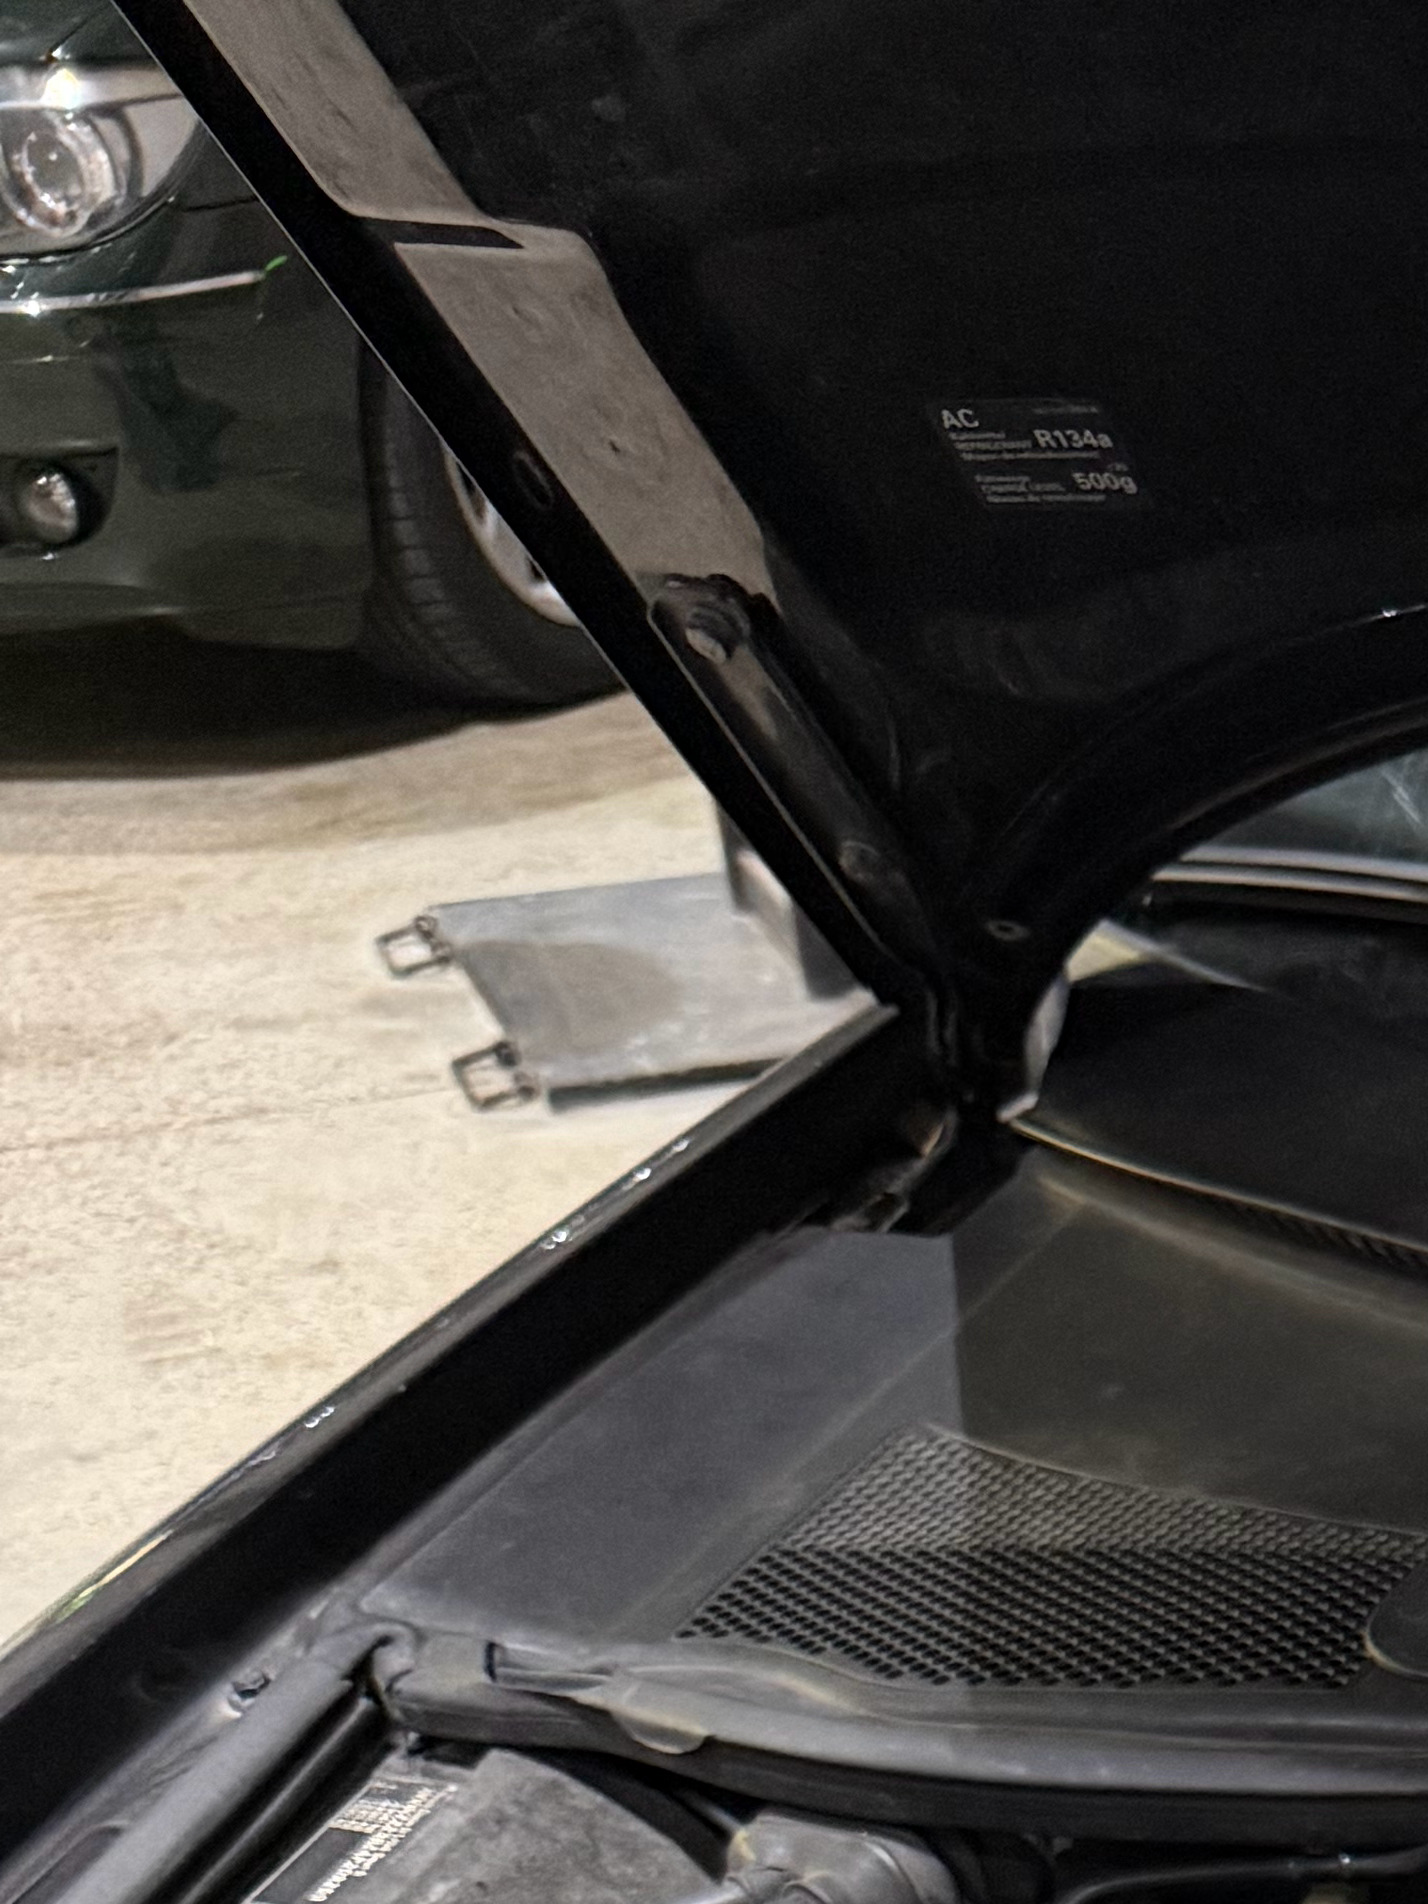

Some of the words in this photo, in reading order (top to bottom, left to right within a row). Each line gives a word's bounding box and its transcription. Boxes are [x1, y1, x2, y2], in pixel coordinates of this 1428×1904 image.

[940, 407, 980, 430] AC
[1032, 428, 1114, 449] R134a
[1071, 471, 1139, 495] 500g
